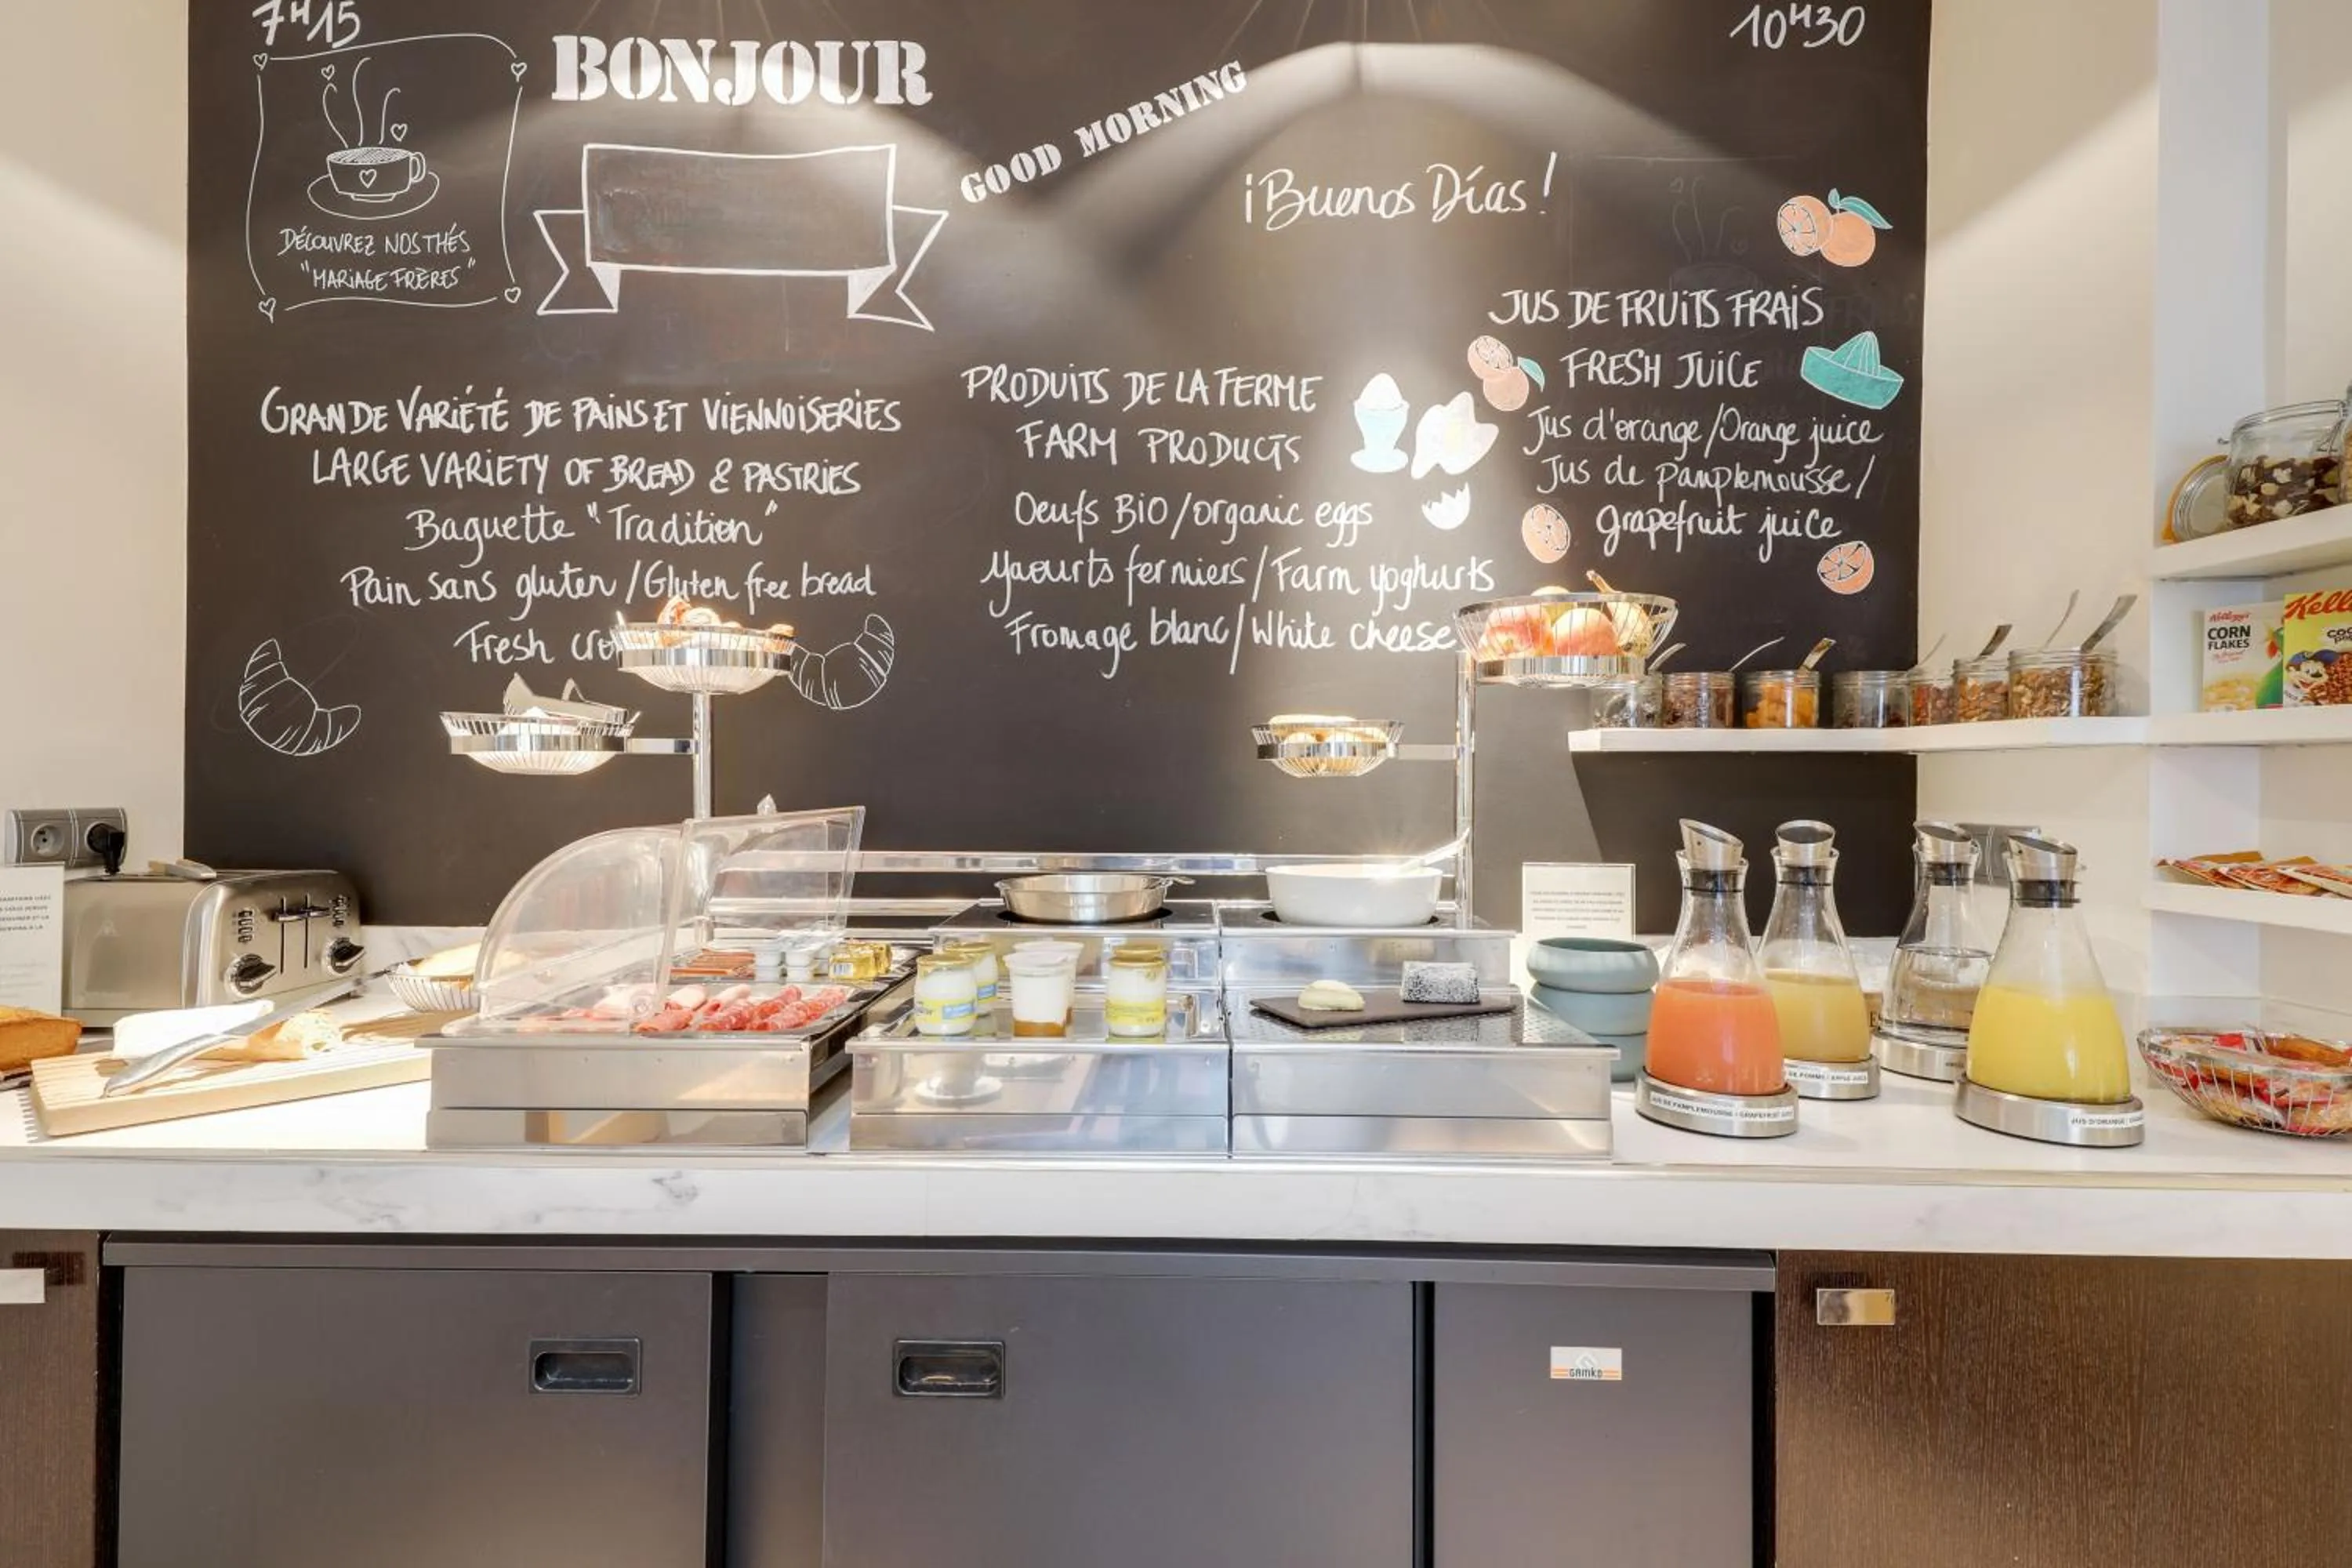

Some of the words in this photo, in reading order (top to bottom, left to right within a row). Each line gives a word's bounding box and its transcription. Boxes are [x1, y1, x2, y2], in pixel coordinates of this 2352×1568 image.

[551, 34, 934, 106] BONJOUR
[960, 143, 1062, 203] GOOD
[1073, 60, 1248, 158] MORNING
[277, 225, 376, 257] DÉCOUVREZ
[384, 232, 421, 255] NOS
[422, 222, 470, 256] THÉS
[1489, 289, 1559, 325] JUS
[1568, 290, 1612, 329] DE
[1616, 288, 1720, 329] FRUITS
[1726, 285, 1824, 331] FRAIS
[960, 363, 1110, 409] PRODUITS
[1122, 370, 1168, 412] DE
[1176, 368, 1210, 406] LA
[1213, 366, 1324, 412] FERME
[1558, 347, 1661, 389] FRESH
[1672, 350, 1763, 390] JUICE
[260, 386, 390, 437] GRANDE
[522, 399, 563, 437] DE
[572, 394, 649, 433] PAINS
[652, 399, 689, 433] ET
[1015, 419, 1117, 466] FARM
[1137, 427, 1303, 471] PRODUCTS
[1523, 405, 1573, 456] Jus
[1804, 413, 1884, 470] juice
[313, 447, 412, 488] LARGE
[419, 449, 550, 495] VARIETY
[564, 456, 604, 487] OF
[601, 453, 695, 496] BREAD
[742, 459, 862, 495] PASTRIES
[1537, 454, 1592, 494] Jus
[1604, 455, 1645, 486] de
[403, 503, 576, 569] Baguette
[1015, 488, 1099, 543] Oeufs
[1315, 500, 1374, 548] eggs
[1758, 506, 1842, 564] juice
[340, 565, 421, 609] Pain
[428, 572, 498, 603] sans
[744, 561, 792, 615] free
[800, 561, 877, 597] bread
[1370, 554, 1495, 617] yoghurts
[2284, 589, 2352, 620] Kell
[452, 620, 555, 665] Fresh
[1004, 610, 1138, 679] Fromage
[1349, 619, 1457, 652] cheese
[2208, 625, 2251, 641] CORN
[2208, 638, 2249, 652] FLAKES
